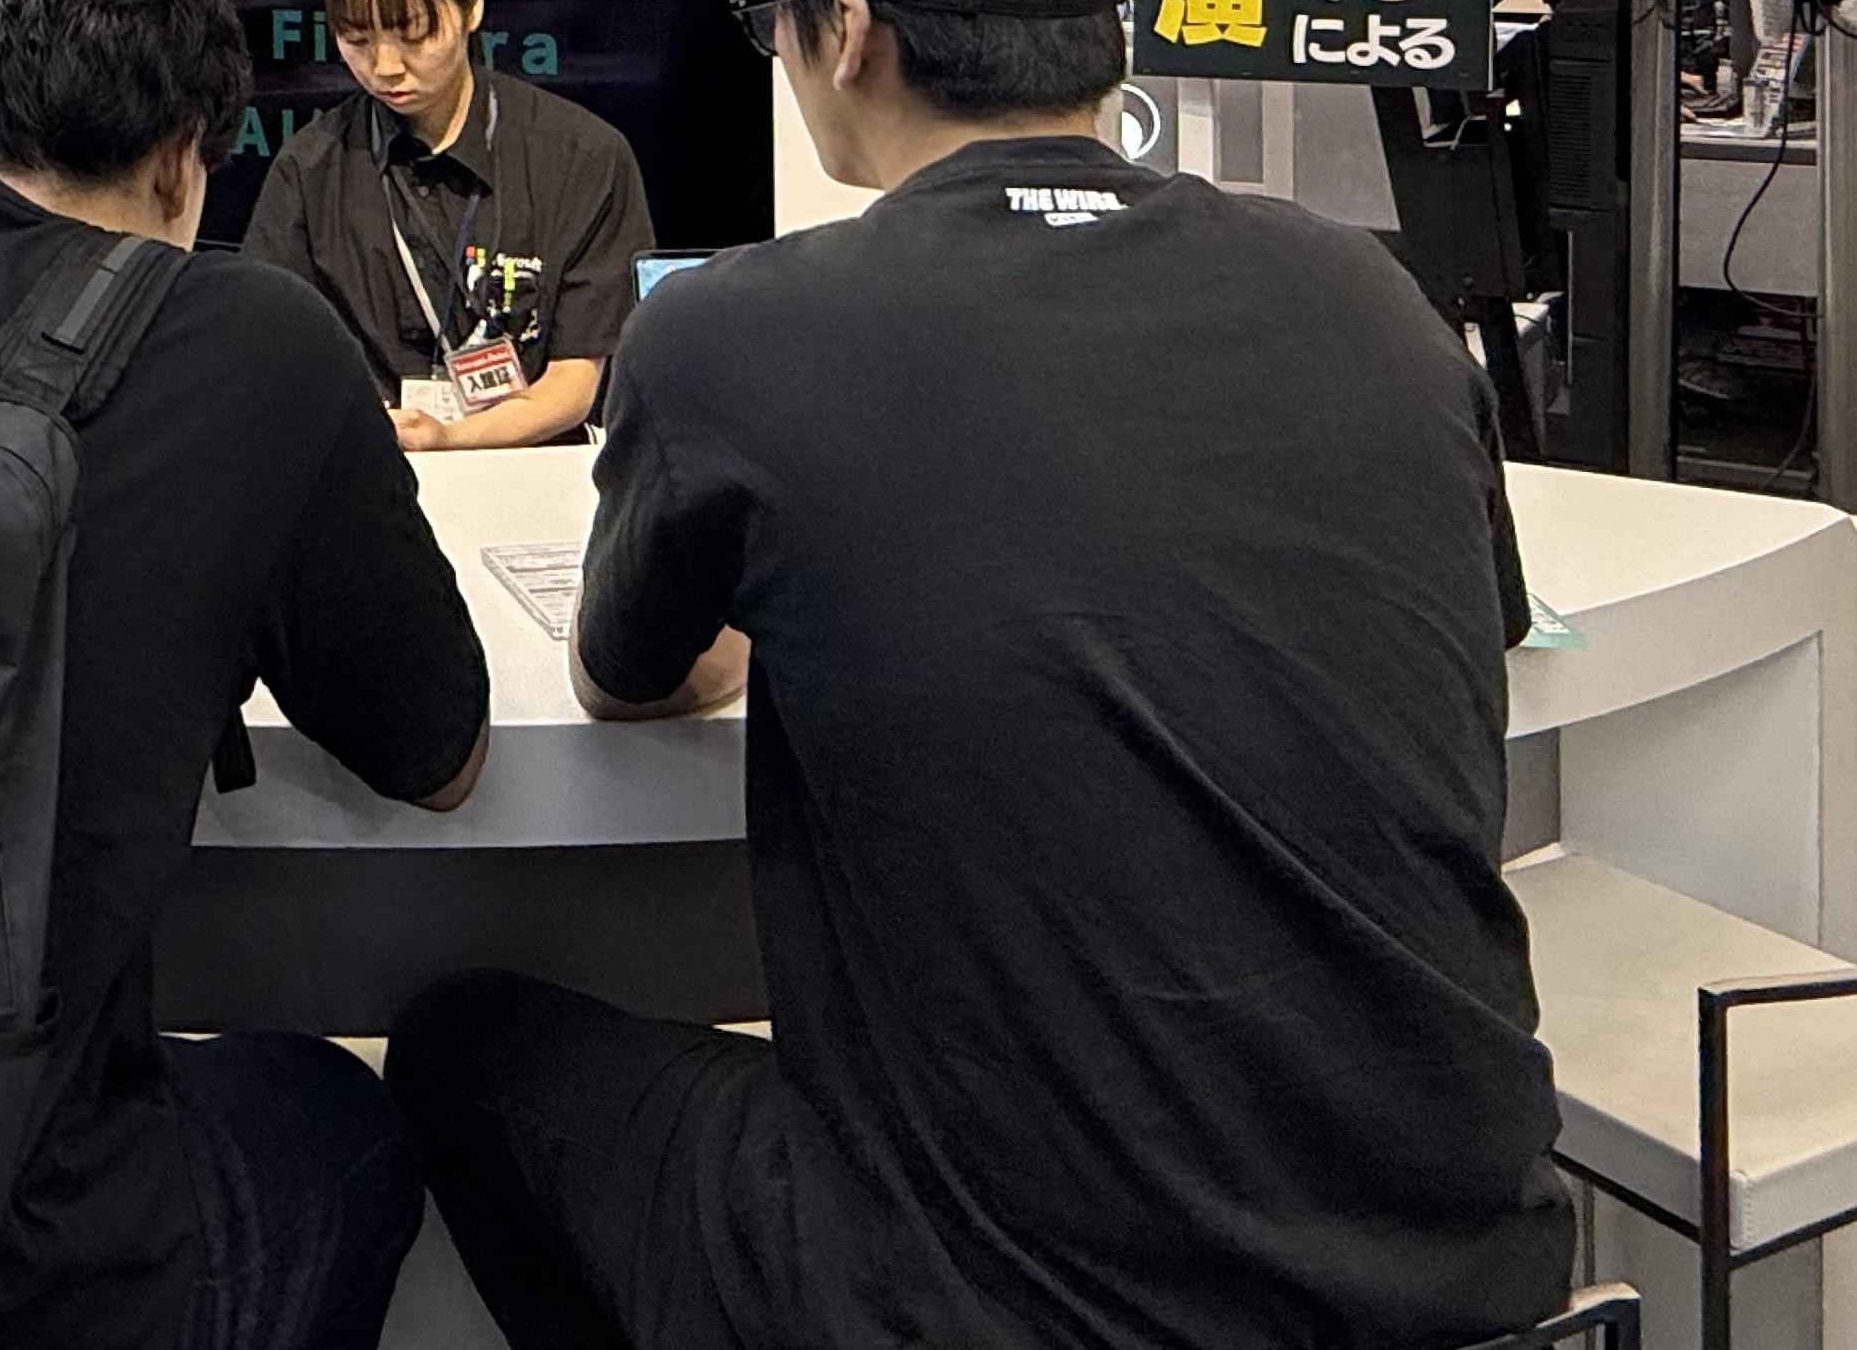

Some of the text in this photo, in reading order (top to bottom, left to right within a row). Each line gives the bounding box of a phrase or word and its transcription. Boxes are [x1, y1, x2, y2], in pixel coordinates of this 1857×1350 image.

[1293, 14, 1455, 71] による
[1005, 187, 1053, 211] THE
